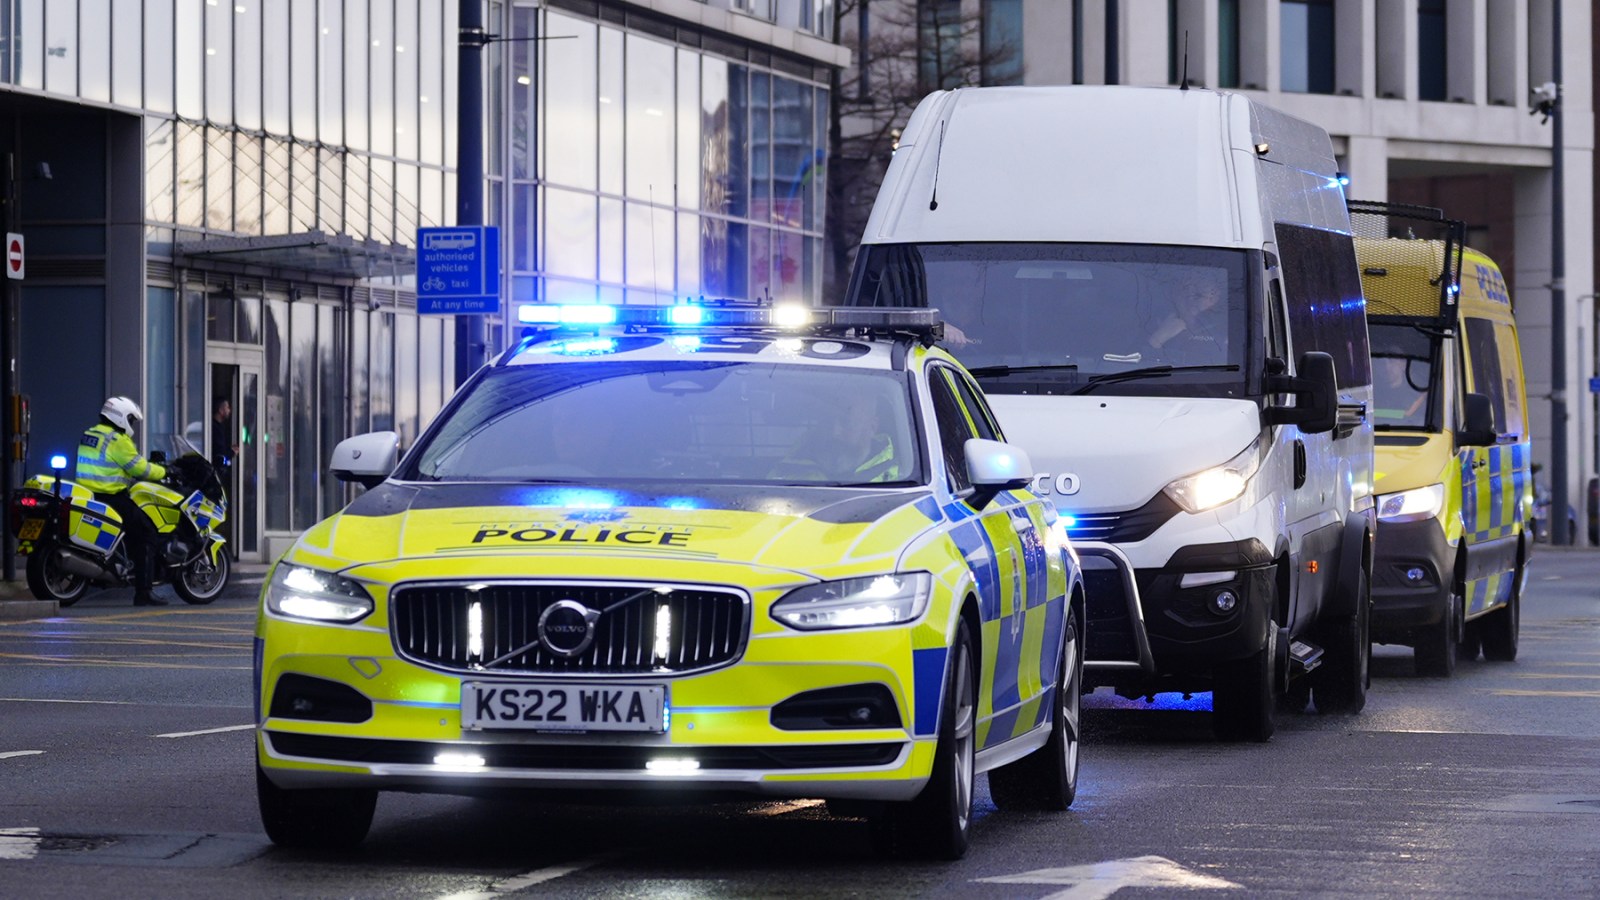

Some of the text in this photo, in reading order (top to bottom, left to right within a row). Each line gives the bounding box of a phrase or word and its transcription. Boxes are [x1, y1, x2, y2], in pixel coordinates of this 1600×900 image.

[424, 252, 475, 261] authorised
[430, 263, 469, 272] vehicles
[451, 279, 469, 288] taxi
[431, 300, 485, 310] At any time
[479, 522, 695, 533] MERSEYSIDE
[471, 529, 692, 547] POLICE
[546, 625, 586, 633] VOLVO
[475, 688, 647, 723] KS22 WKA
